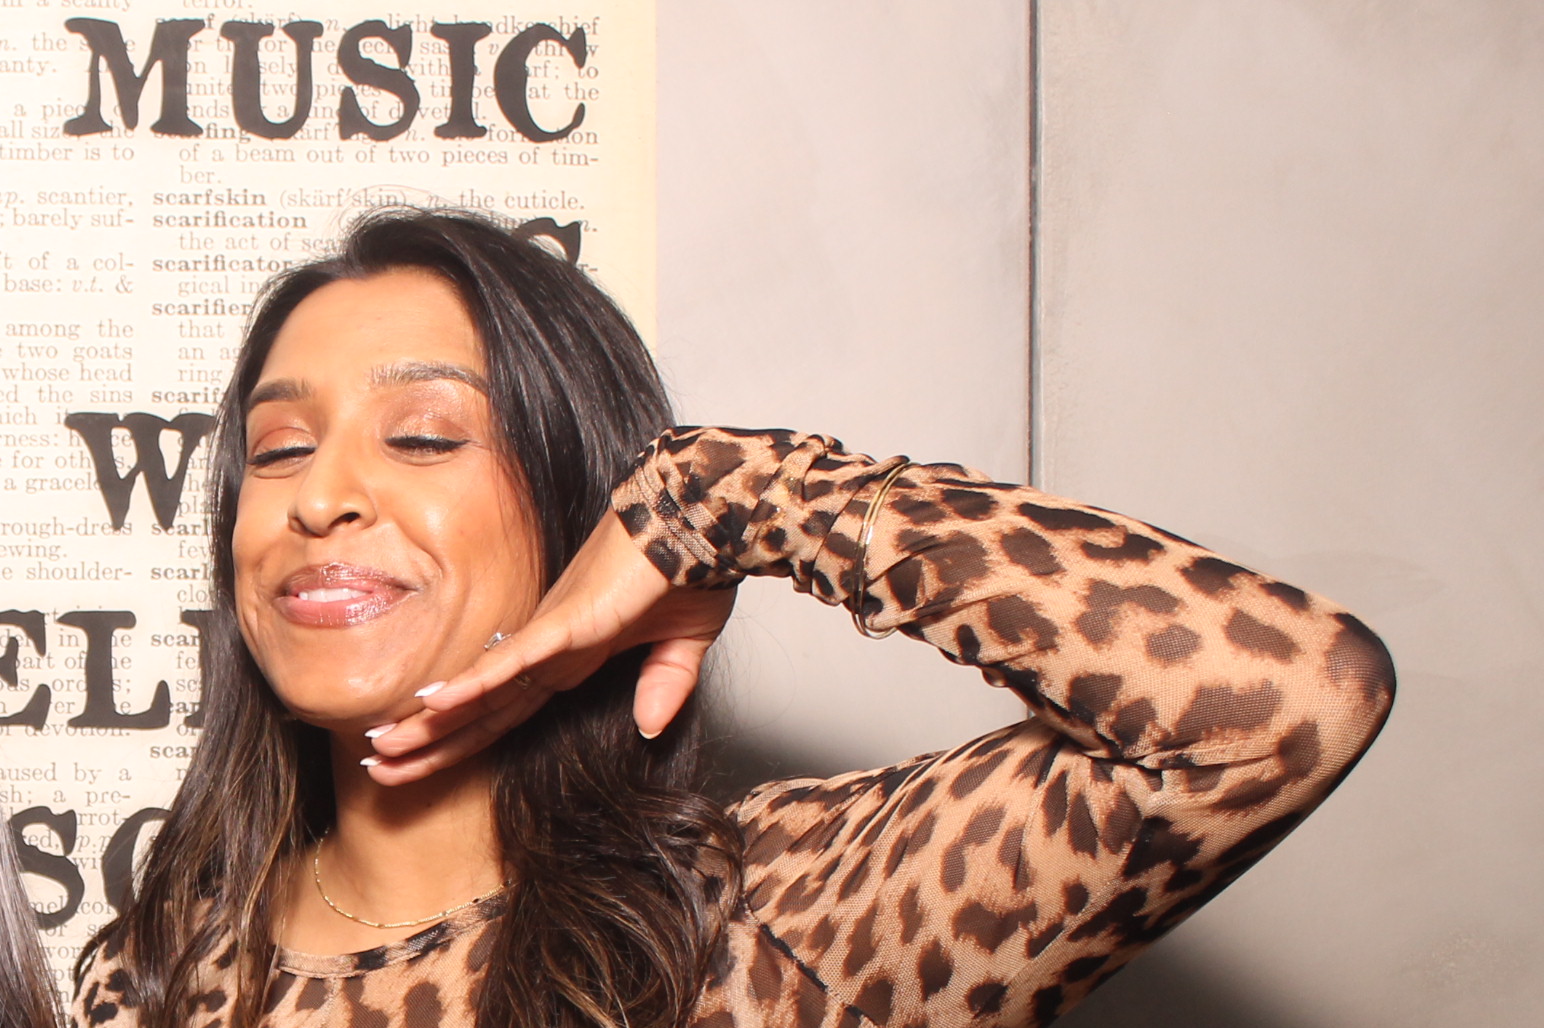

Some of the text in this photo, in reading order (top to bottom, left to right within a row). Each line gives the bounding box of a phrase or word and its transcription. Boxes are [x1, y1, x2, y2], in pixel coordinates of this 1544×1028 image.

[388, 13, 435, 34] liht
[32, 32, 68, 51] the
[225, 56, 297, 77] lsely
[64, 17, 587, 143] MUSIC
[315, 79, 381, 99] piees
[528, 84, 551, 99] at
[565, 82, 599, 100] the
[13, 105, 27, 117] a
[41, 98, 87, 120] piec
[277, 105, 290, 118] a
[31, 121, 80, 140] siz,
[0, 142, 73, 161] timber
[84, 143, 101, 160] is
[113, 145, 135, 161] to
[179, 145, 599, 166] of a beam out of two pieces of tim-
[180, 166, 223, 184] ber.
[37, 187, 134, 208] scantier,
[152, 188, 266, 206] scarfskin
[459, 189, 495, 208] the
[504, 190, 585, 210] cuticle.
[12, 209, 83, 230] barely
[91, 209, 134, 227] suf-
[152, 210, 307, 228] scarification
[179, 232, 214, 250] the
[225, 233, 259, 250] act
[270, 233, 291, 250] of
[28, 251, 52, 271] of
[66, 258, 79, 271] a
[93, 251, 135, 271] col-
[4, 274, 62, 293] base:
[72, 276, 104, 293] v.t.
[115, 276, 134, 294] &
[178, 275, 229, 296] gical
[152, 299, 252, 316] scarifier
[6, 323, 80, 341] among
[98, 318, 133, 338] the
[178, 320, 225, 338] that
[17, 342, 58, 359] two
[73, 343, 133, 362] goats
[178, 347, 204, 360] an
[2, 362, 69, 381] whose
[79, 361, 132, 381] head
[178, 363, 223, 383] ring
[38, 383, 73, 402] the
[90, 385, 133, 402] sins
[68, 428, 132, 448] hce
[12, 450, 44, 468] for
[55, 450, 133, 470] oths,
[4, 479, 17, 490] a
[26, 562, 133, 580] shoulder-
[59, 629, 79, 647] in
[73, 762, 102, 784] by
[118, 769, 132, 780] a
[53, 790, 131, 807] a pre-
